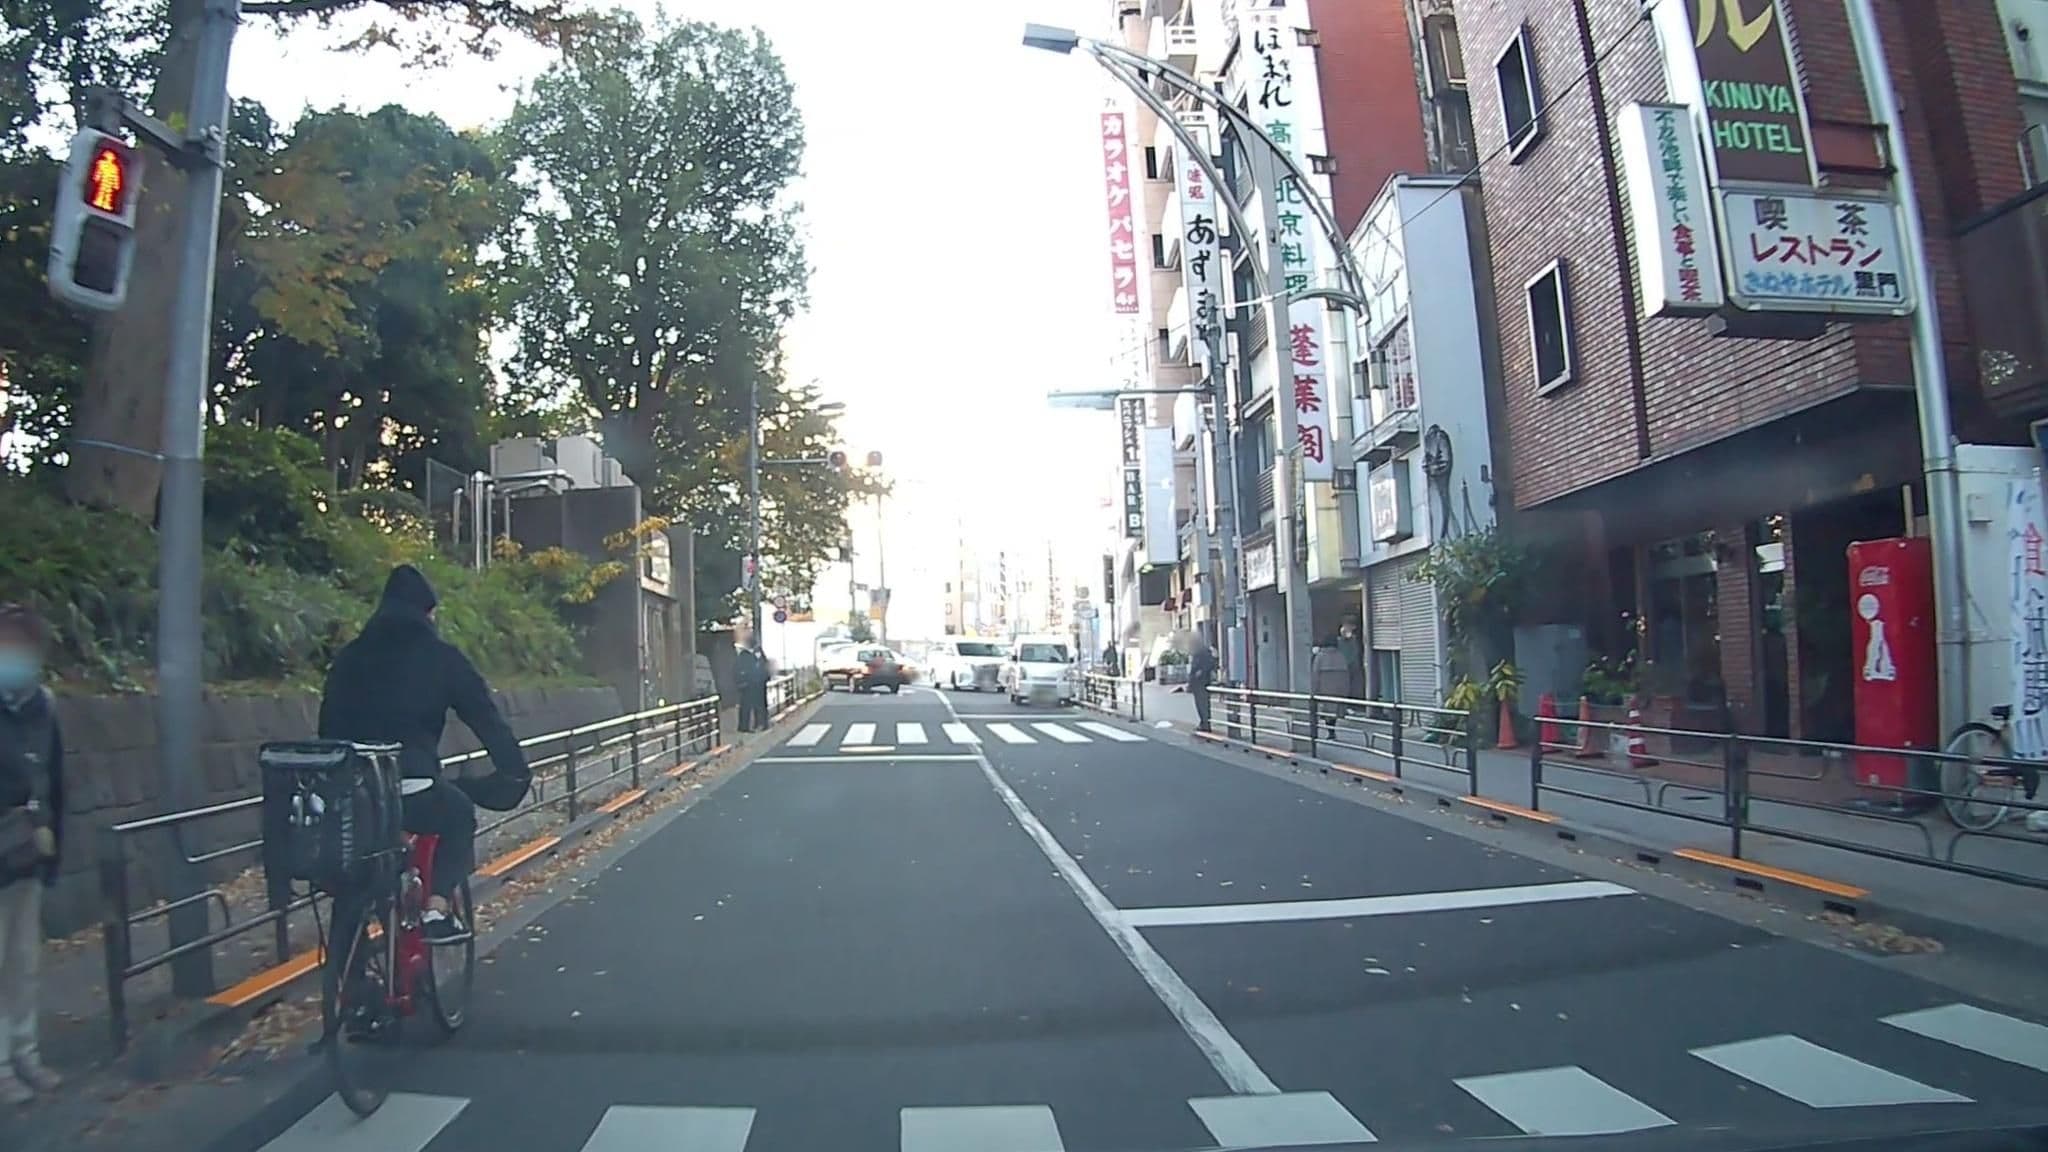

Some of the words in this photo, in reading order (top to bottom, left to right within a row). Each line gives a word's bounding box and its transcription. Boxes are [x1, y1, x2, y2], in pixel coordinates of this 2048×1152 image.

[1254, 27, 1292, 109] ほまれ
[1702, 79, 1796, 114] KINUYA
[1711, 119, 1804, 154] HOTEL
[1750, 233, 1882, 267] レストラン
